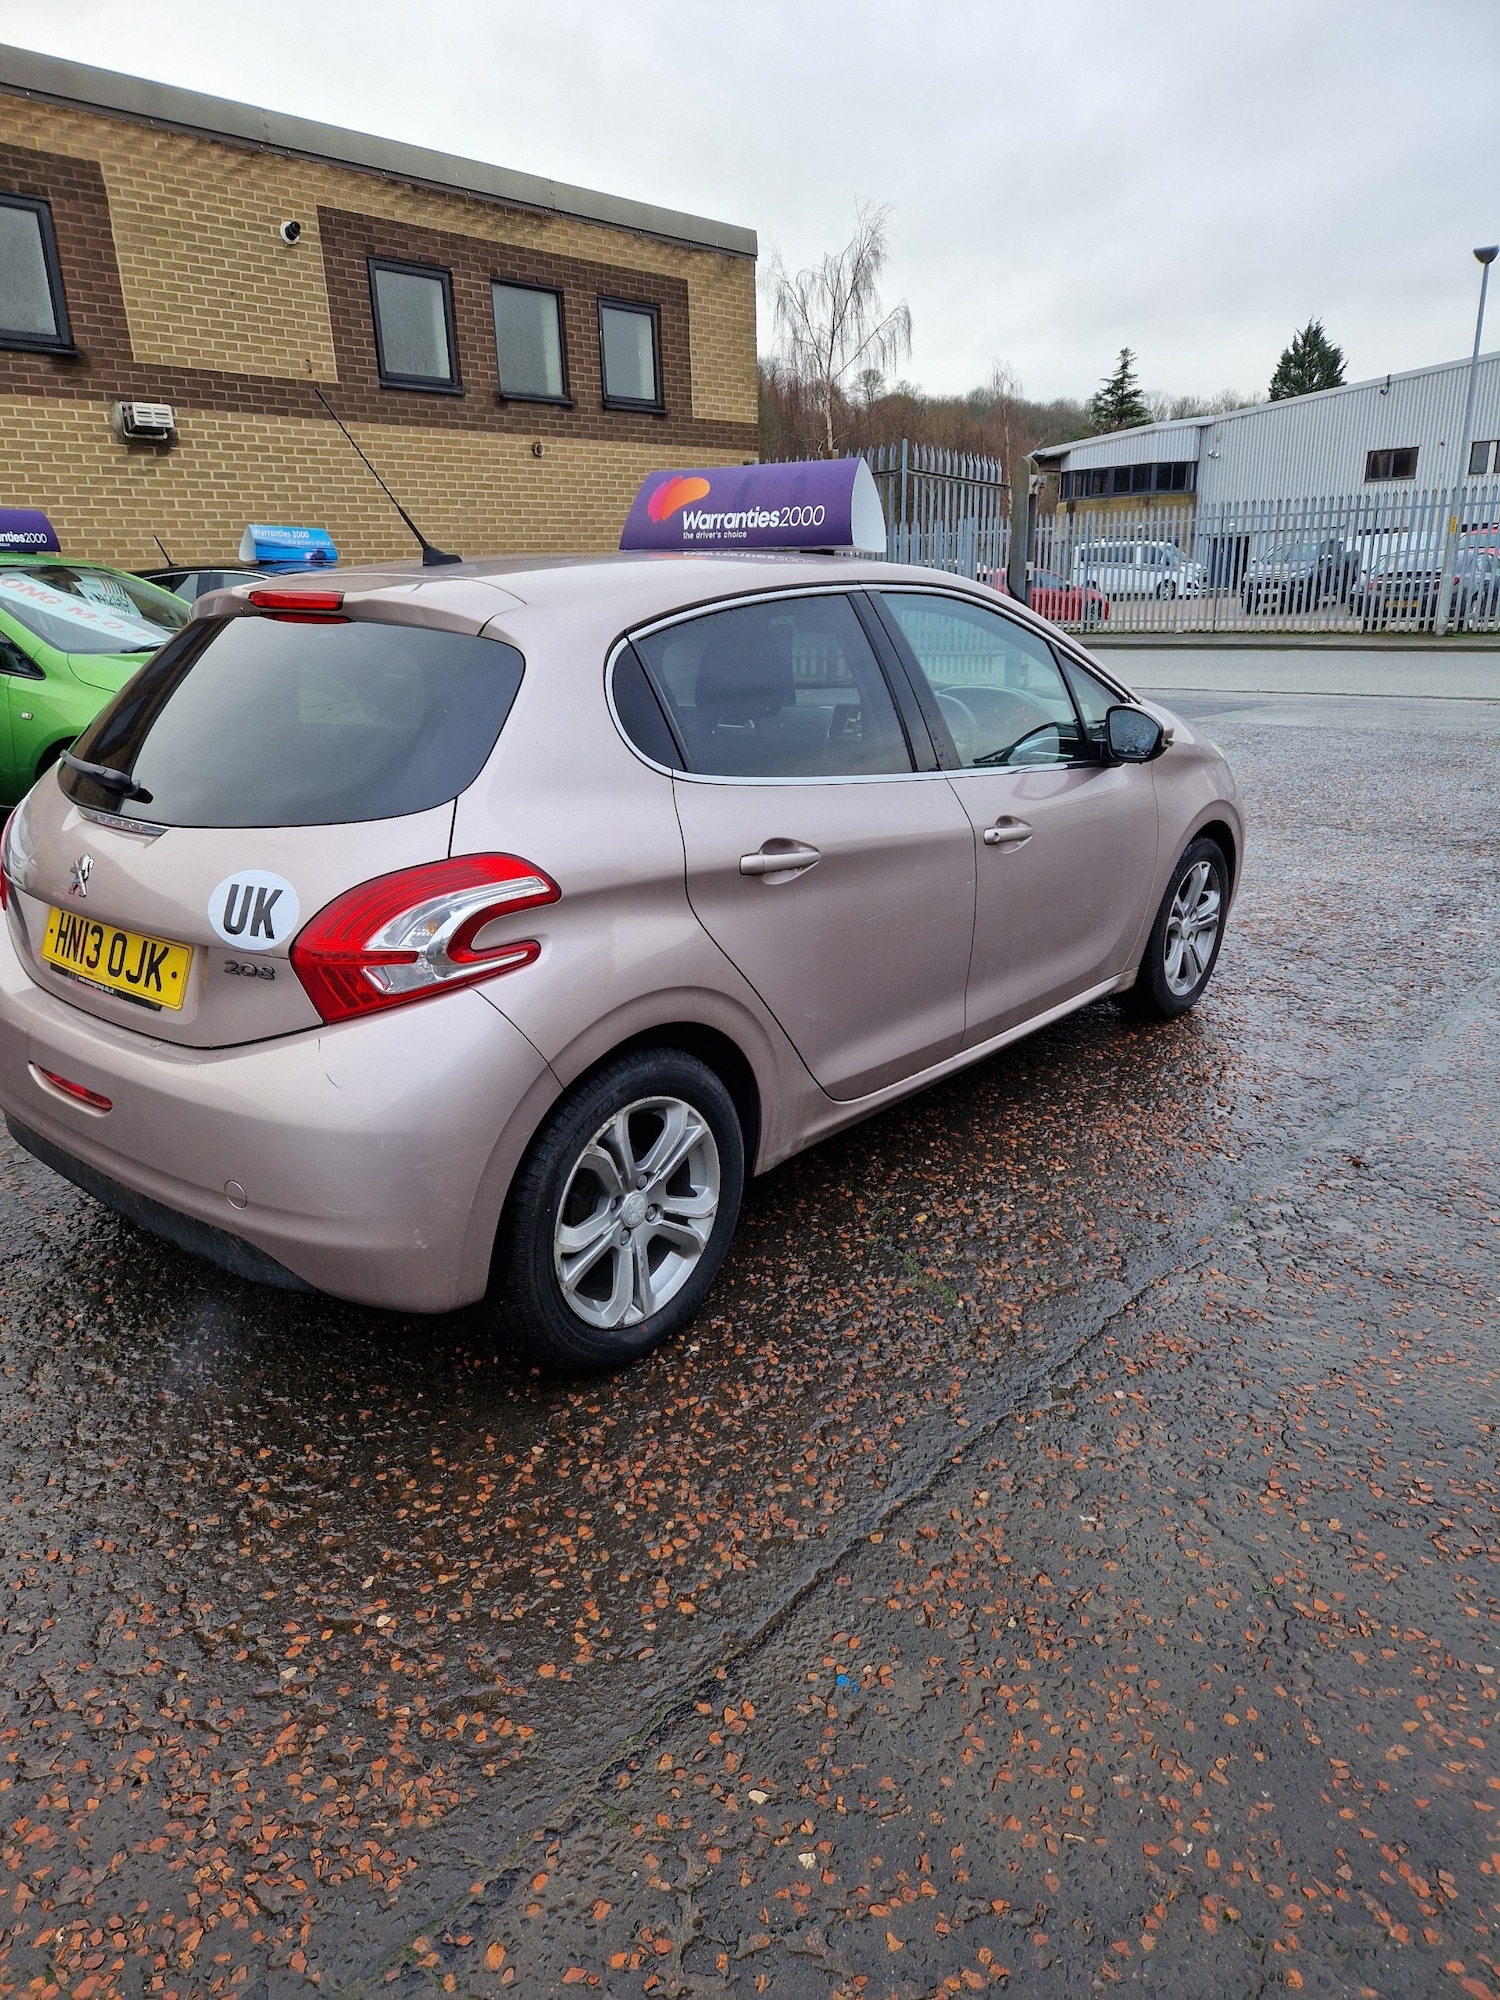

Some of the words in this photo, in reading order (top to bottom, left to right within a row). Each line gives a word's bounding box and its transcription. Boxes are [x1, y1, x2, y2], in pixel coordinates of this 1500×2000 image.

[682, 505, 826, 530] Warranties2000
[0, 531, 48, 544] nties2000
[252, 527, 292, 538] Warranties
[292, 529, 310, 540] 2000
[683, 531, 694, 540] the
[696, 530, 722, 539] driver's
[723, 530, 748, 539] choice
[223, 883, 284, 940] UK
[54, 912, 104, 969] HN13
[107, 932, 170, 993] OJK
[223, 960, 276, 980] 208
